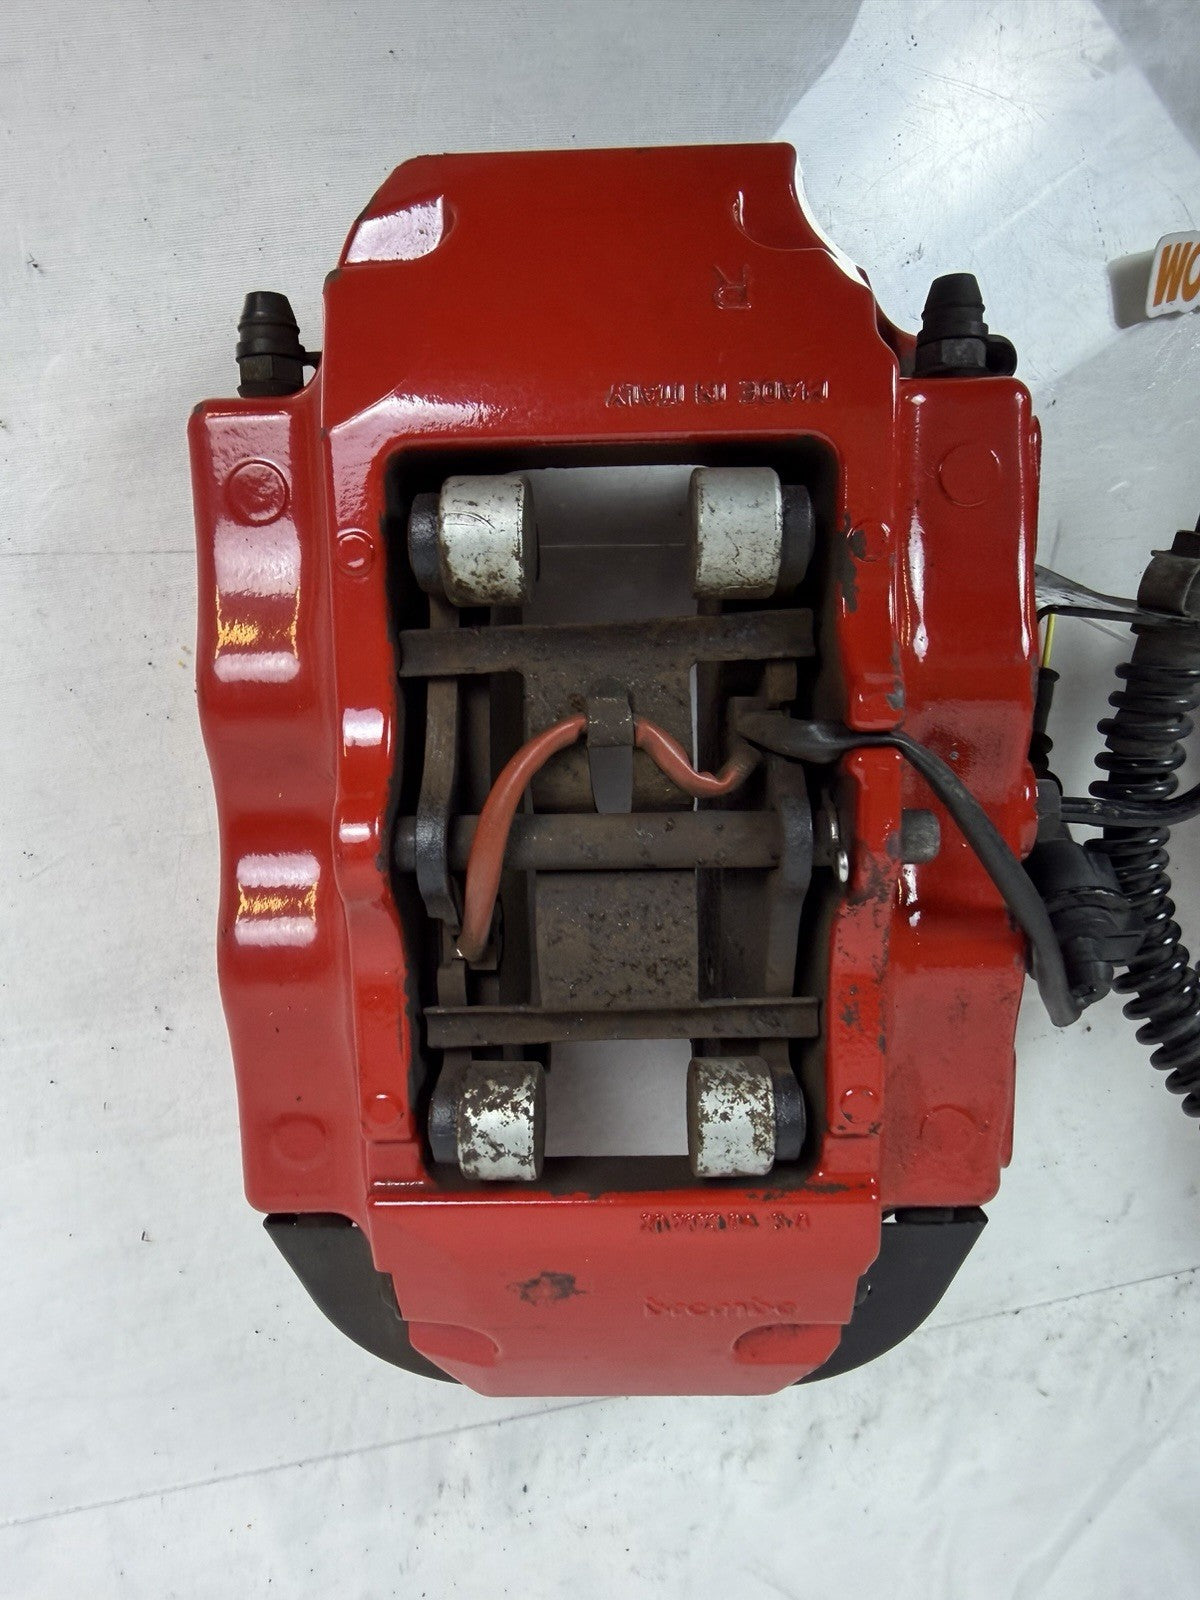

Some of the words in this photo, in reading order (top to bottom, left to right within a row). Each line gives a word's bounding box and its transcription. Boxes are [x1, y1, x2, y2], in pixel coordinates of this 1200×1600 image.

[712, 262, 753, 311] R
[604, 382, 687, 408] ITALY
[695, 381, 729, 406] IN
[738, 380, 830, 406] MADE
[643, 1295, 798, 1319] brembo
